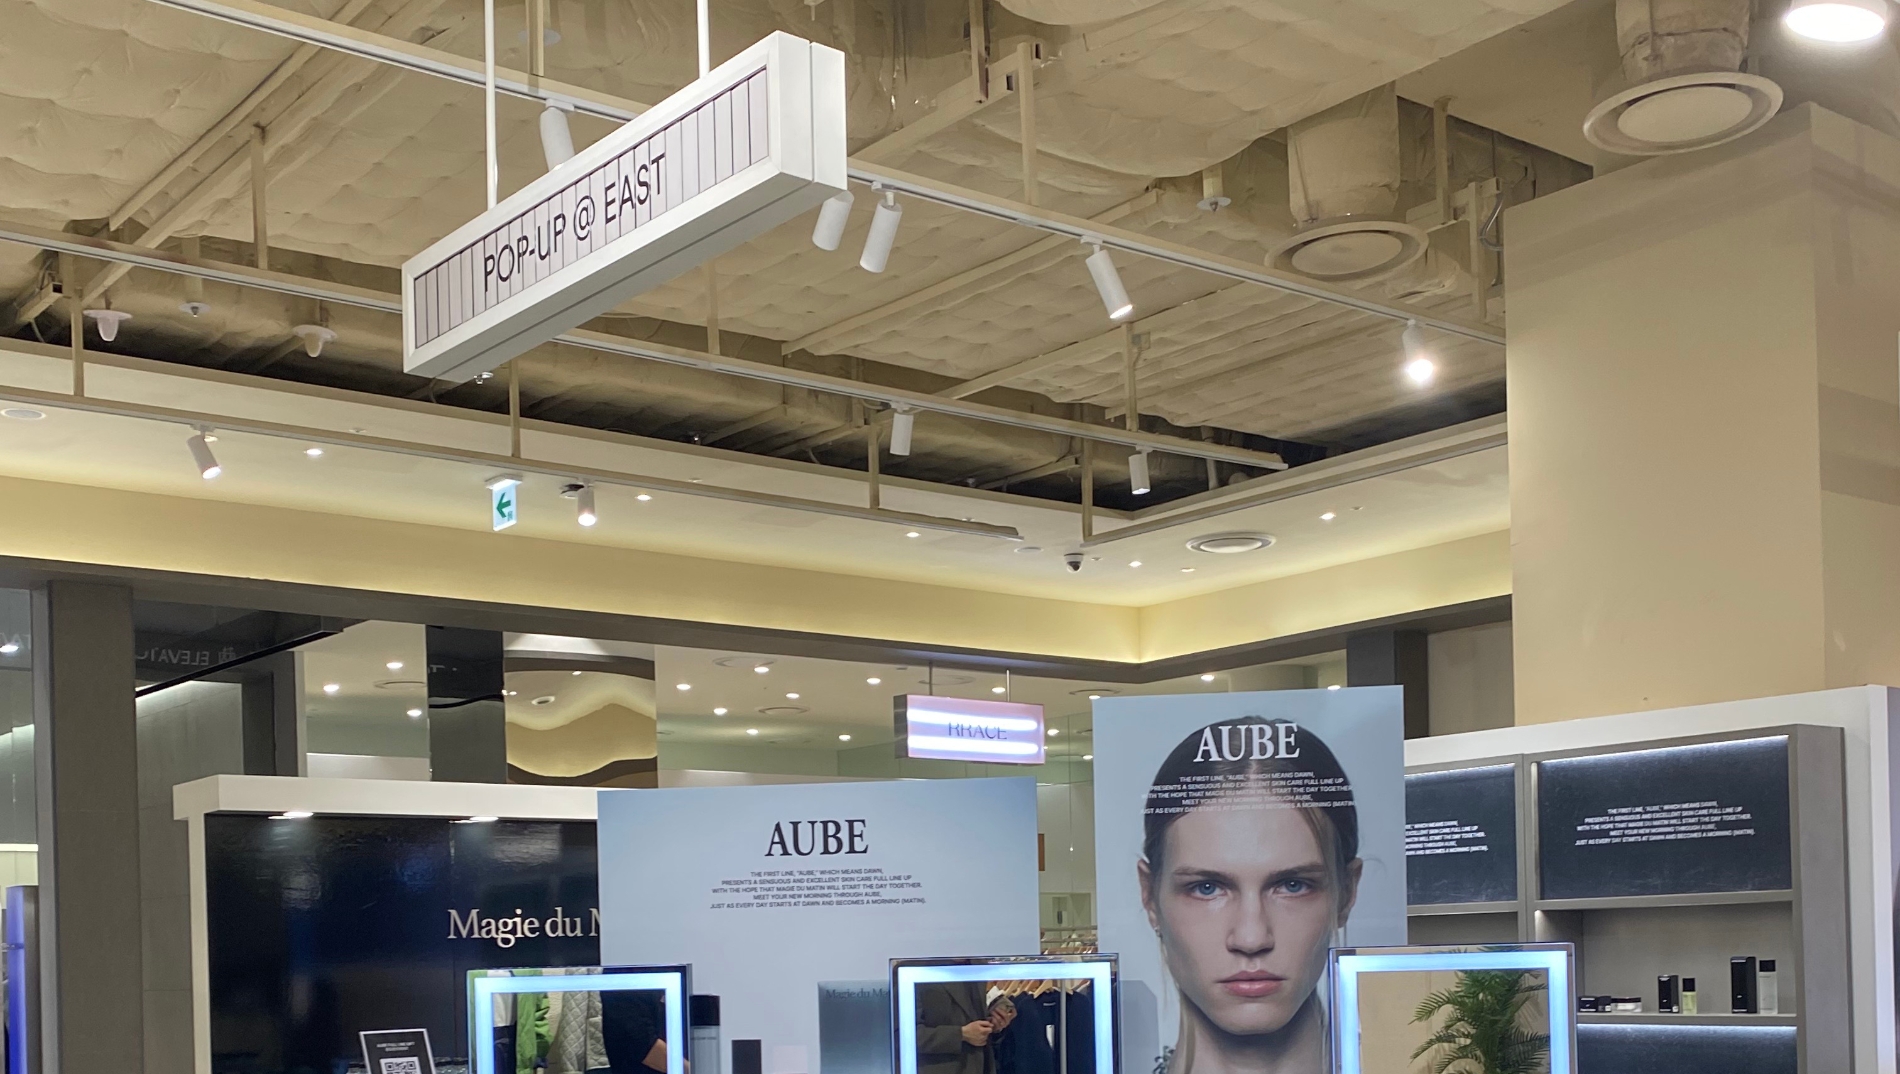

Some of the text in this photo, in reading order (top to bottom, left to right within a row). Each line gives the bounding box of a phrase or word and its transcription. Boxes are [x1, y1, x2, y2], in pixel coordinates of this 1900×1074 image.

[484, 153, 666, 293] POP-UP @ EAST
[1193, 722, 1300, 763] AUBE
[764, 819, 869, 857] AUBE
[447, 908, 540, 948] Magie
[545, 907, 584, 937] du
